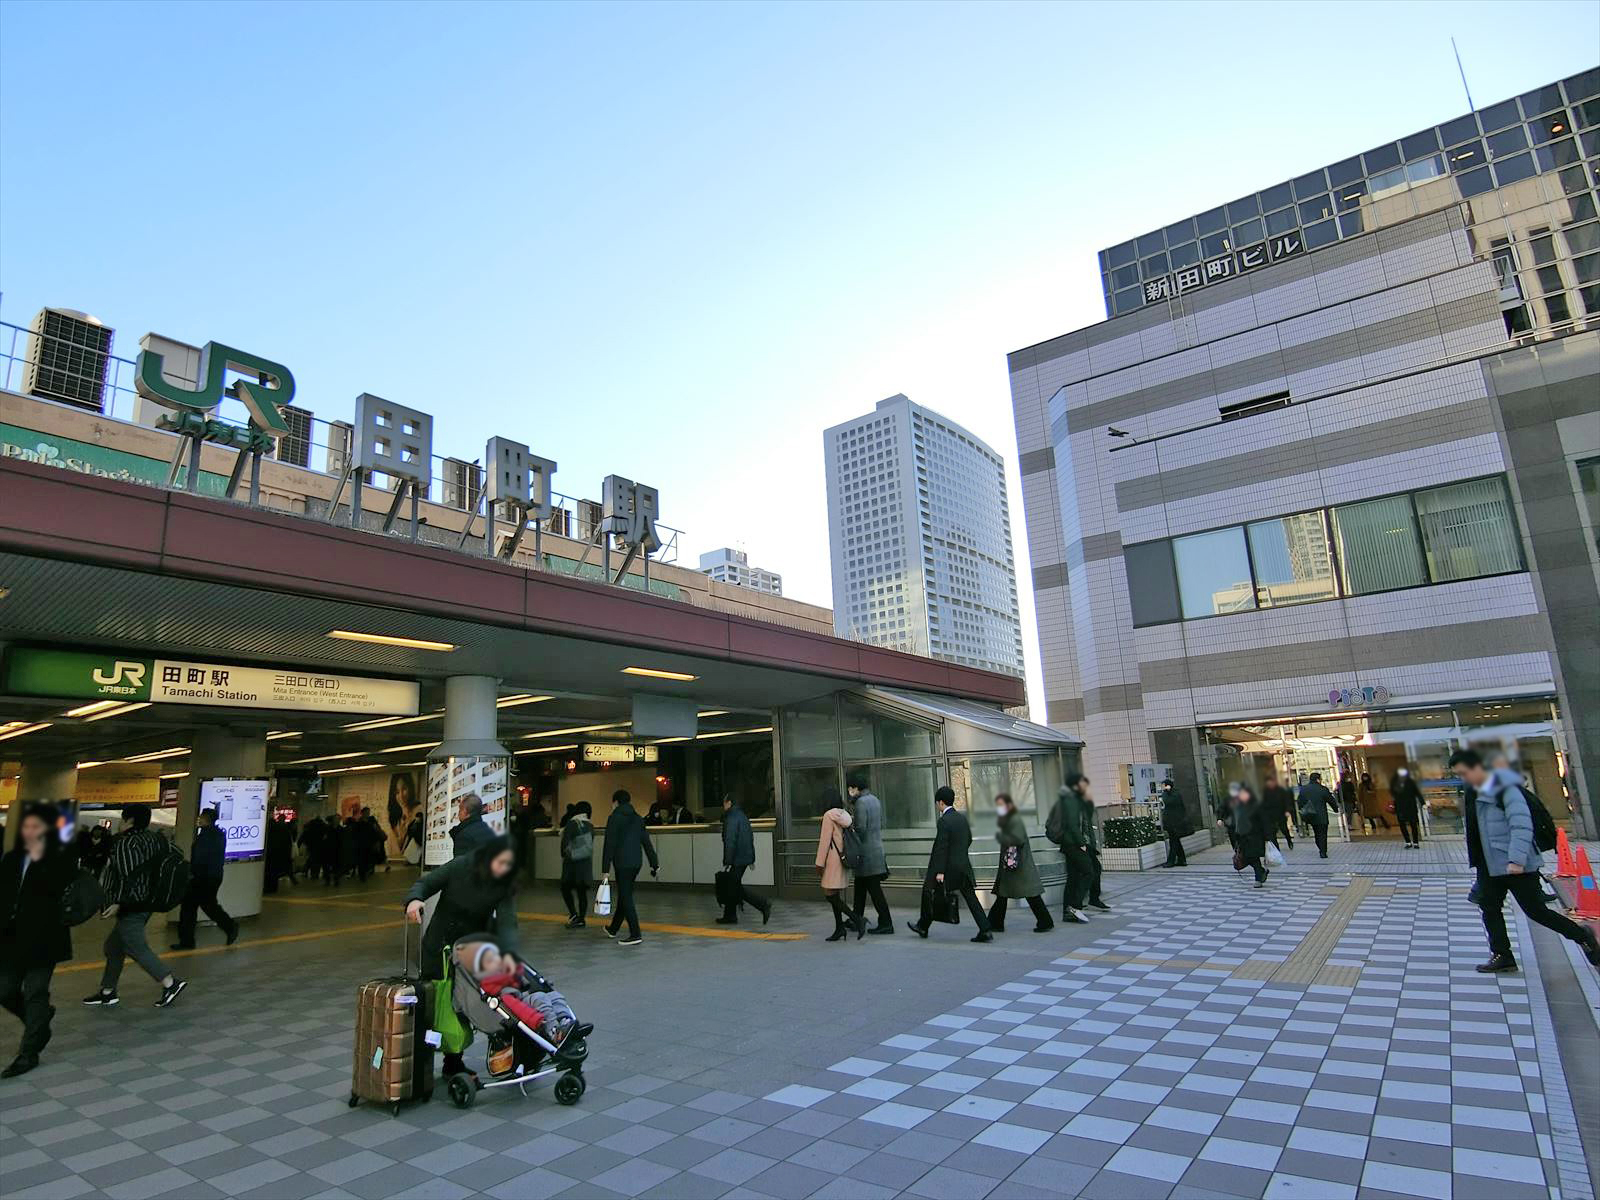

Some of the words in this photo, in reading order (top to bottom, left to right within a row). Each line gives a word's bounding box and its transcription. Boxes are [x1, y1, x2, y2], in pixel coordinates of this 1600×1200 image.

[1147, 237, 1300, 301] 新田町ビル
[135, 340, 296, 438] JR
[352, 392, 662, 553] 田町駅
[92, 660, 146, 687] JR
[162, 666, 230, 687] 田町駅
[274, 674, 341, 690] 三田口(西口)
[98, 686, 137, 695] JR東日本
[162, 685, 213, 699] Tamachi
[216, 689, 258, 702] Station
[289, 688, 318, 696] Entrance
[319, 690, 338, 698] (West
[339, 691, 369, 700] Entrance)
[634, 746, 645, 755] JR
[227, 824, 260, 840] RISO
